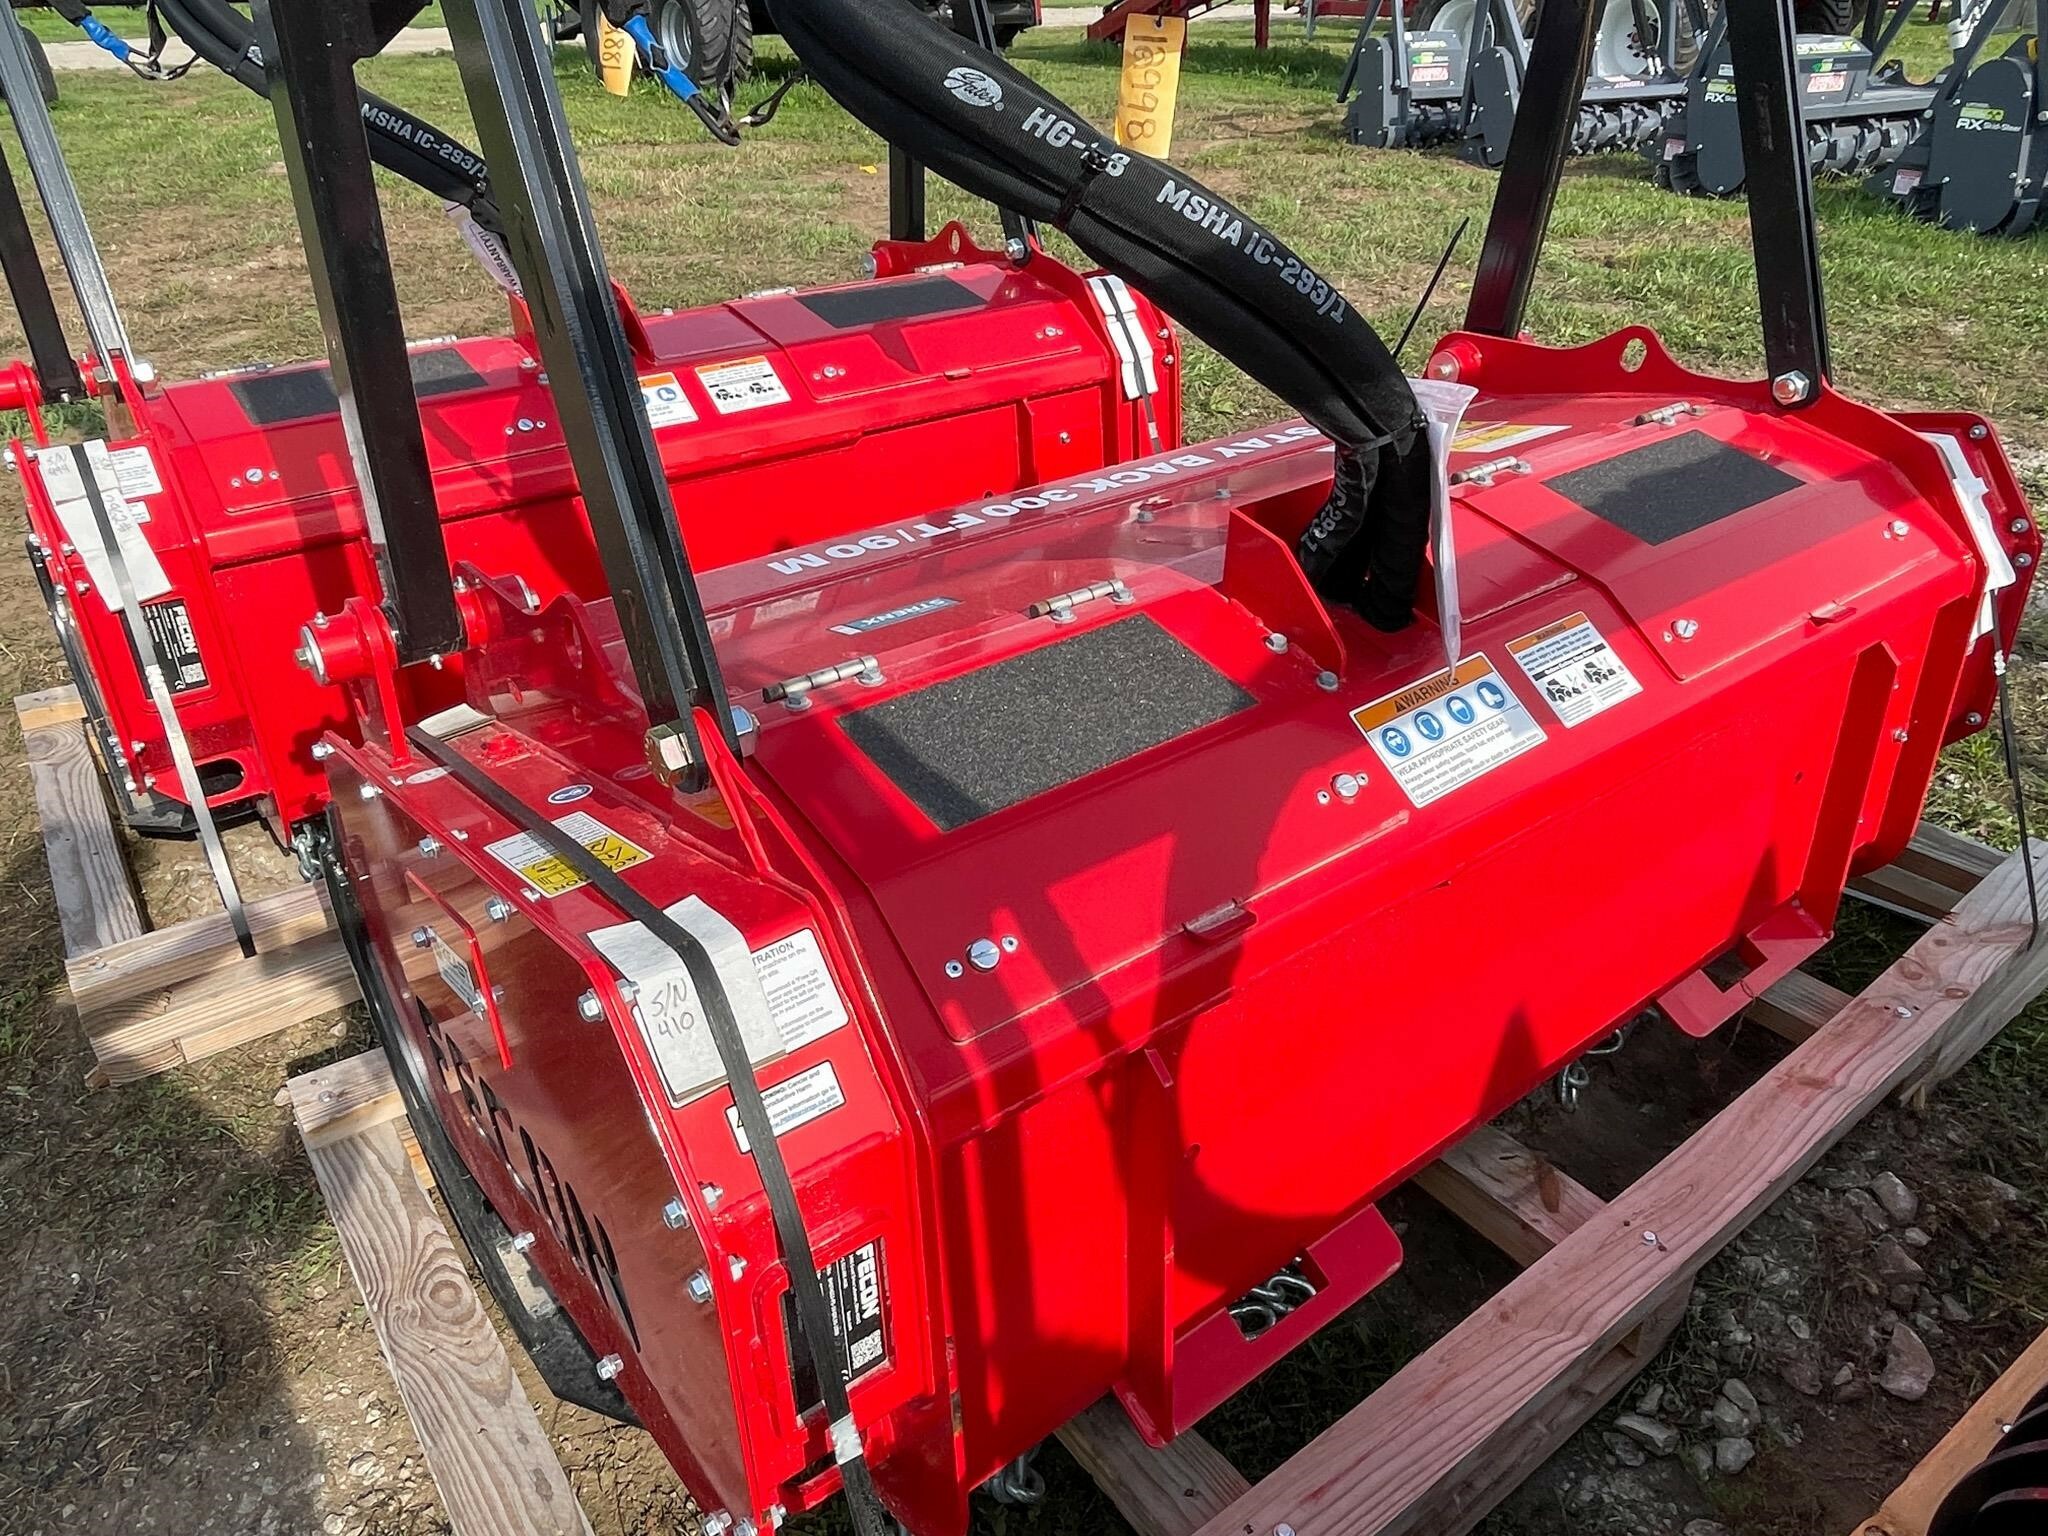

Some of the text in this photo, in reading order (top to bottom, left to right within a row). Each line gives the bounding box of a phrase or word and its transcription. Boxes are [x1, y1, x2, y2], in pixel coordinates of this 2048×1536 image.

[361, 102, 488, 178] MSHA IC-293/1
[1156, 179, 1347, 325] MSHA IC-293/1
[1213, 425, 1323, 459] STAY
[1069, 453, 1216, 495] BACK
[981, 488, 1078, 518] 300
[172, 605, 199, 654] FECON
[863, 597, 946, 627] STRENX
[1399, 672, 1461, 708] WARNING
[1395, 716, 1506, 777] WEAR APPROPRIATE SAFETY GEAR
[651, 977, 687, 1017] S/N
[658, 1011, 695, 1039] 410
[856, 1243, 880, 1319] FECON
